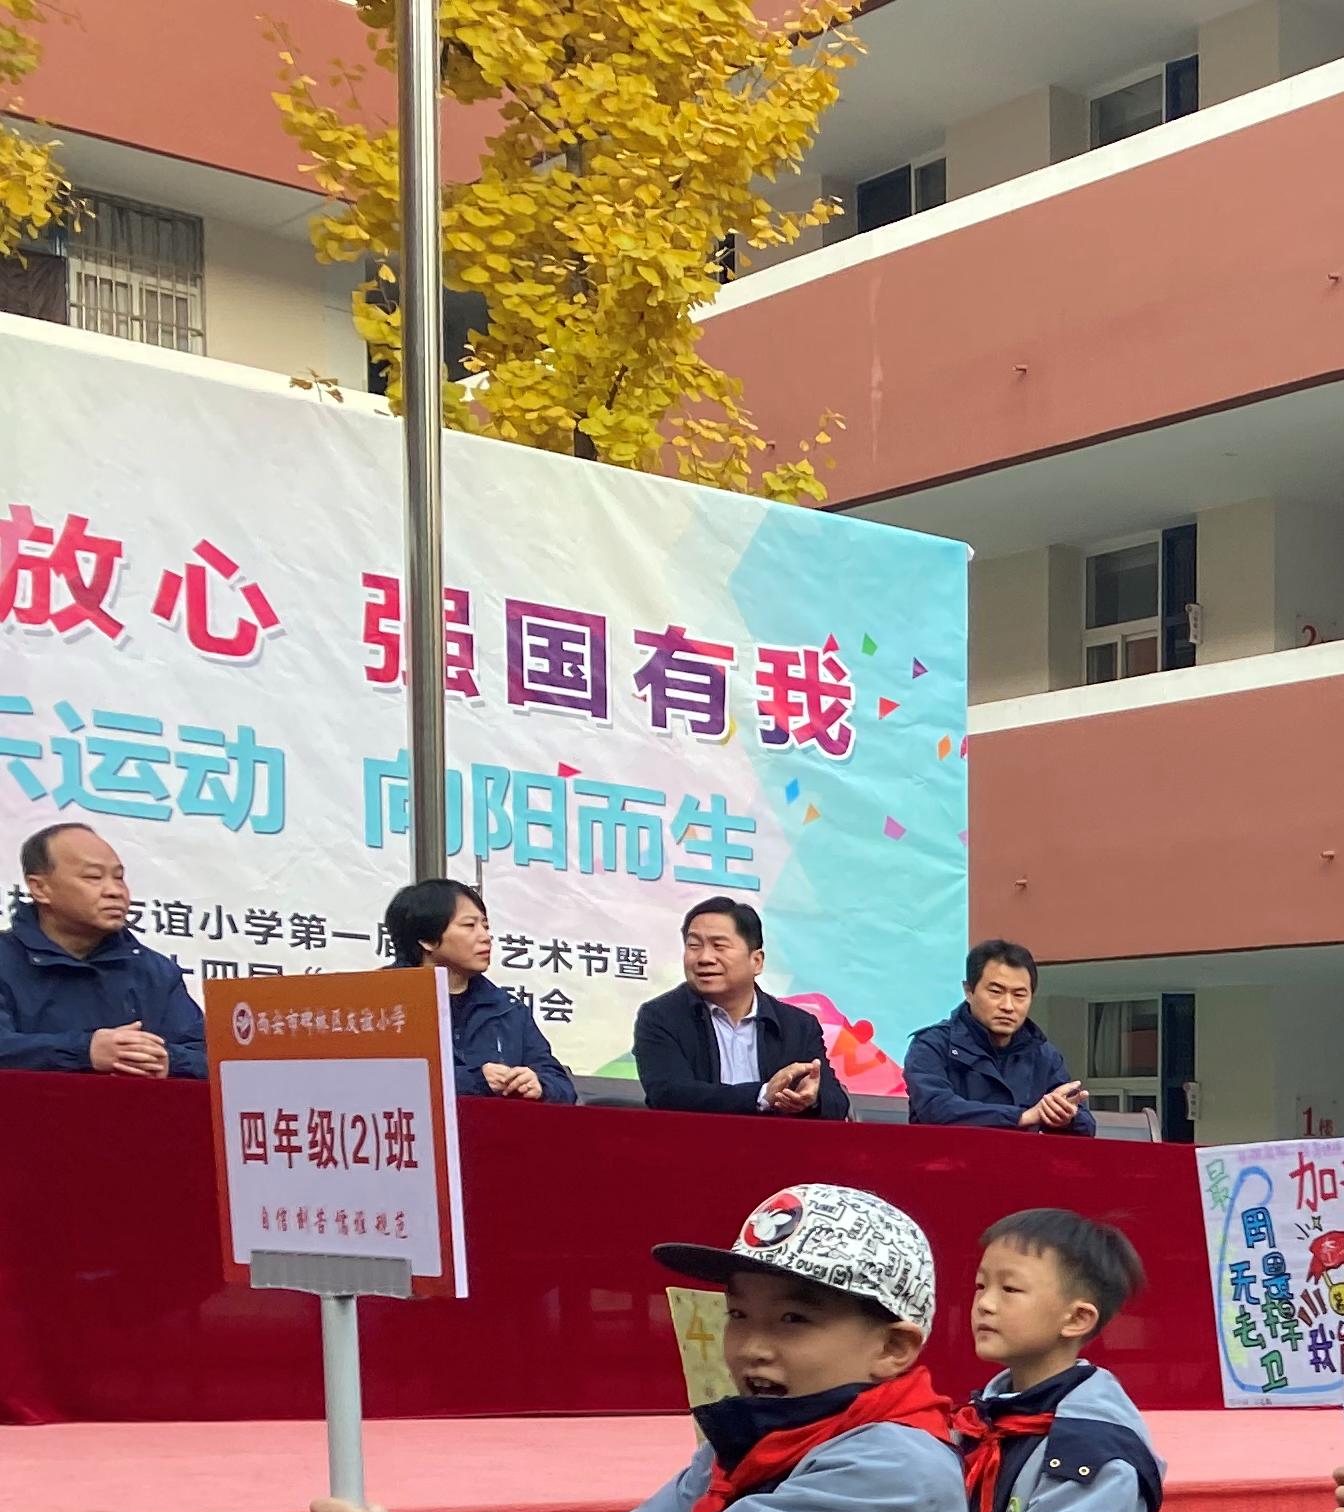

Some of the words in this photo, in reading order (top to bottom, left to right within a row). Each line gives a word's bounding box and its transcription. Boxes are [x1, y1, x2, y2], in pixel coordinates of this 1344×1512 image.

[361, 572, 857, 757] 强国有我
[364, 750, 762, 891] 向阳而生
[239, 1107, 419, 1171] 四年级(2)班
